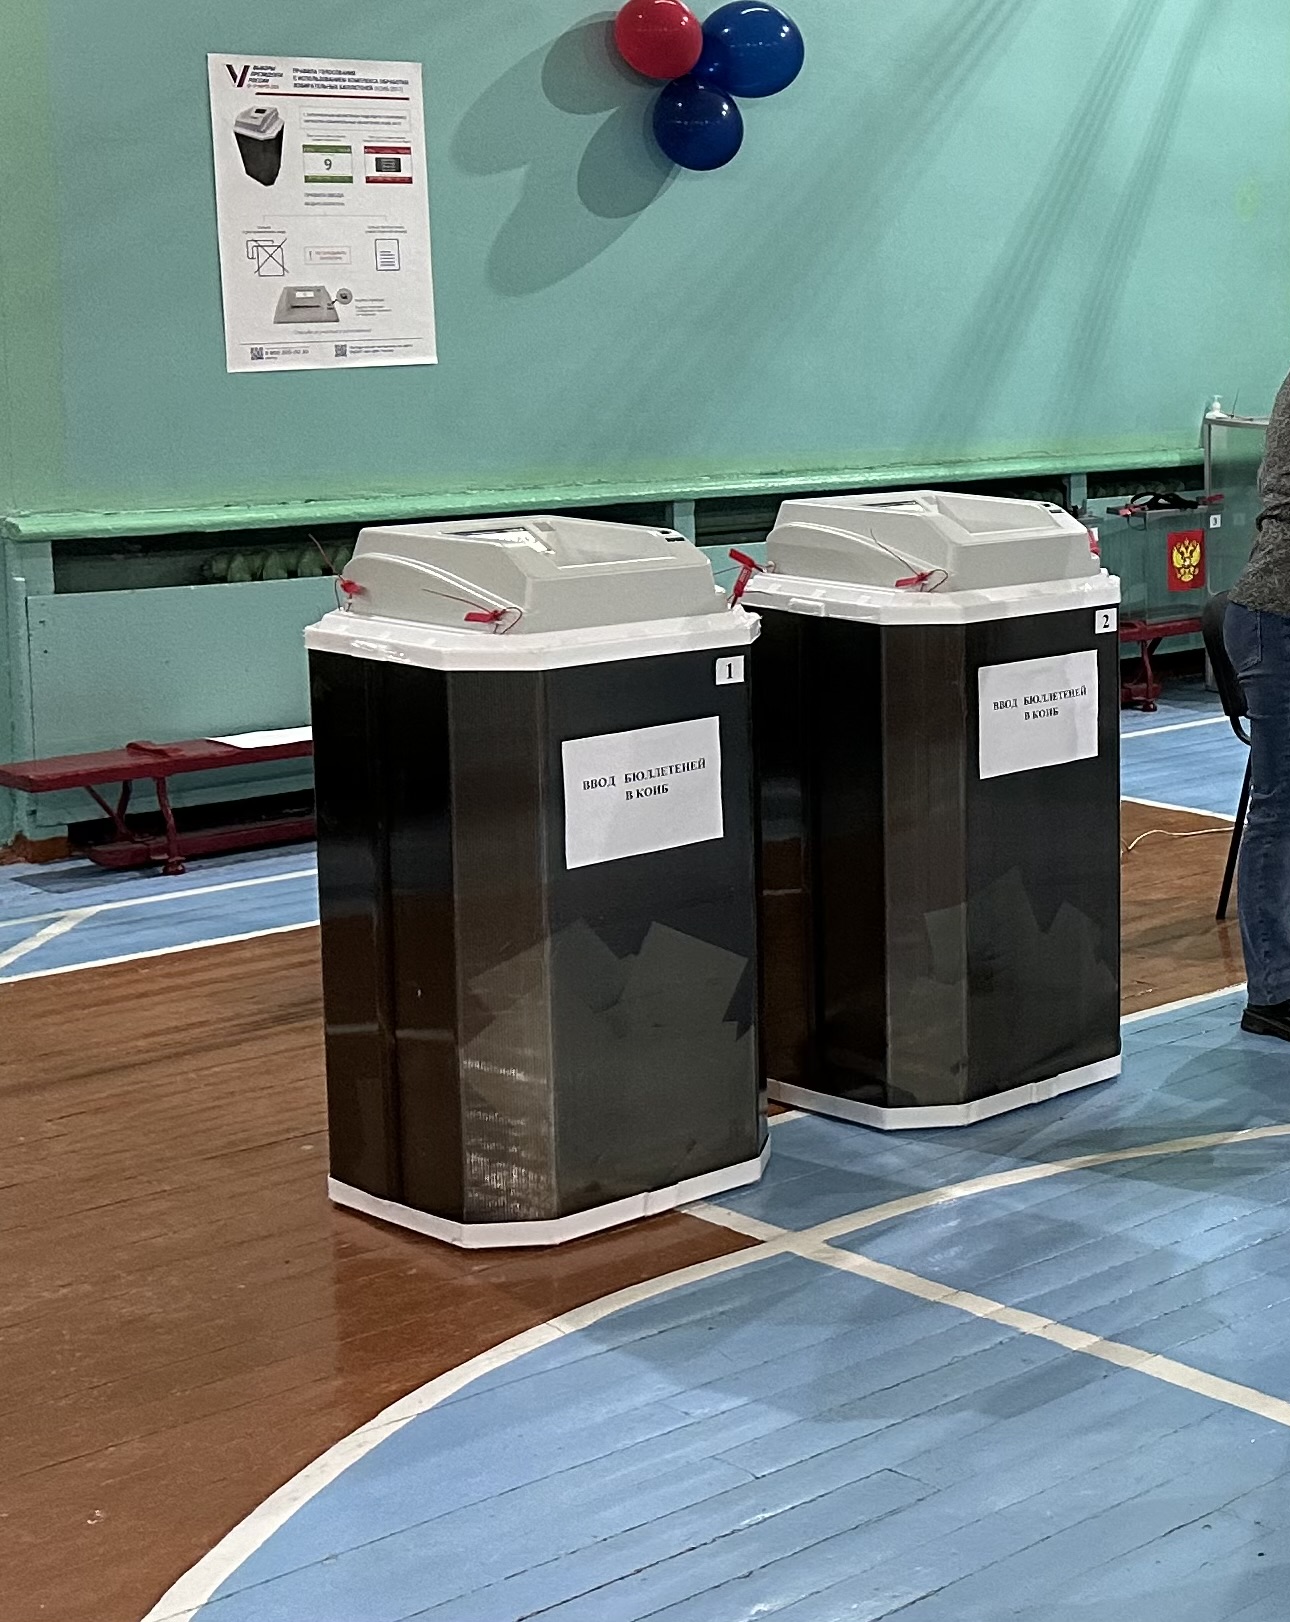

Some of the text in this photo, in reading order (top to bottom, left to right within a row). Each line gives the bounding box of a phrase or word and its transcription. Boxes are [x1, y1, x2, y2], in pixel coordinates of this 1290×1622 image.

[323, 158, 333, 171] 9
[1102, 614, 1110, 629] 2
[726, 662, 734, 680] 1
[992, 685, 1087, 711] ВВОД БЮЛЛЕТЕНЕЙ
[1024, 706, 1059, 721] В КОИБ
[582, 757, 706, 791] ВВОД БЮЛЛЕТЕНЕЙ
[625, 783, 669, 801] В КОИБ
